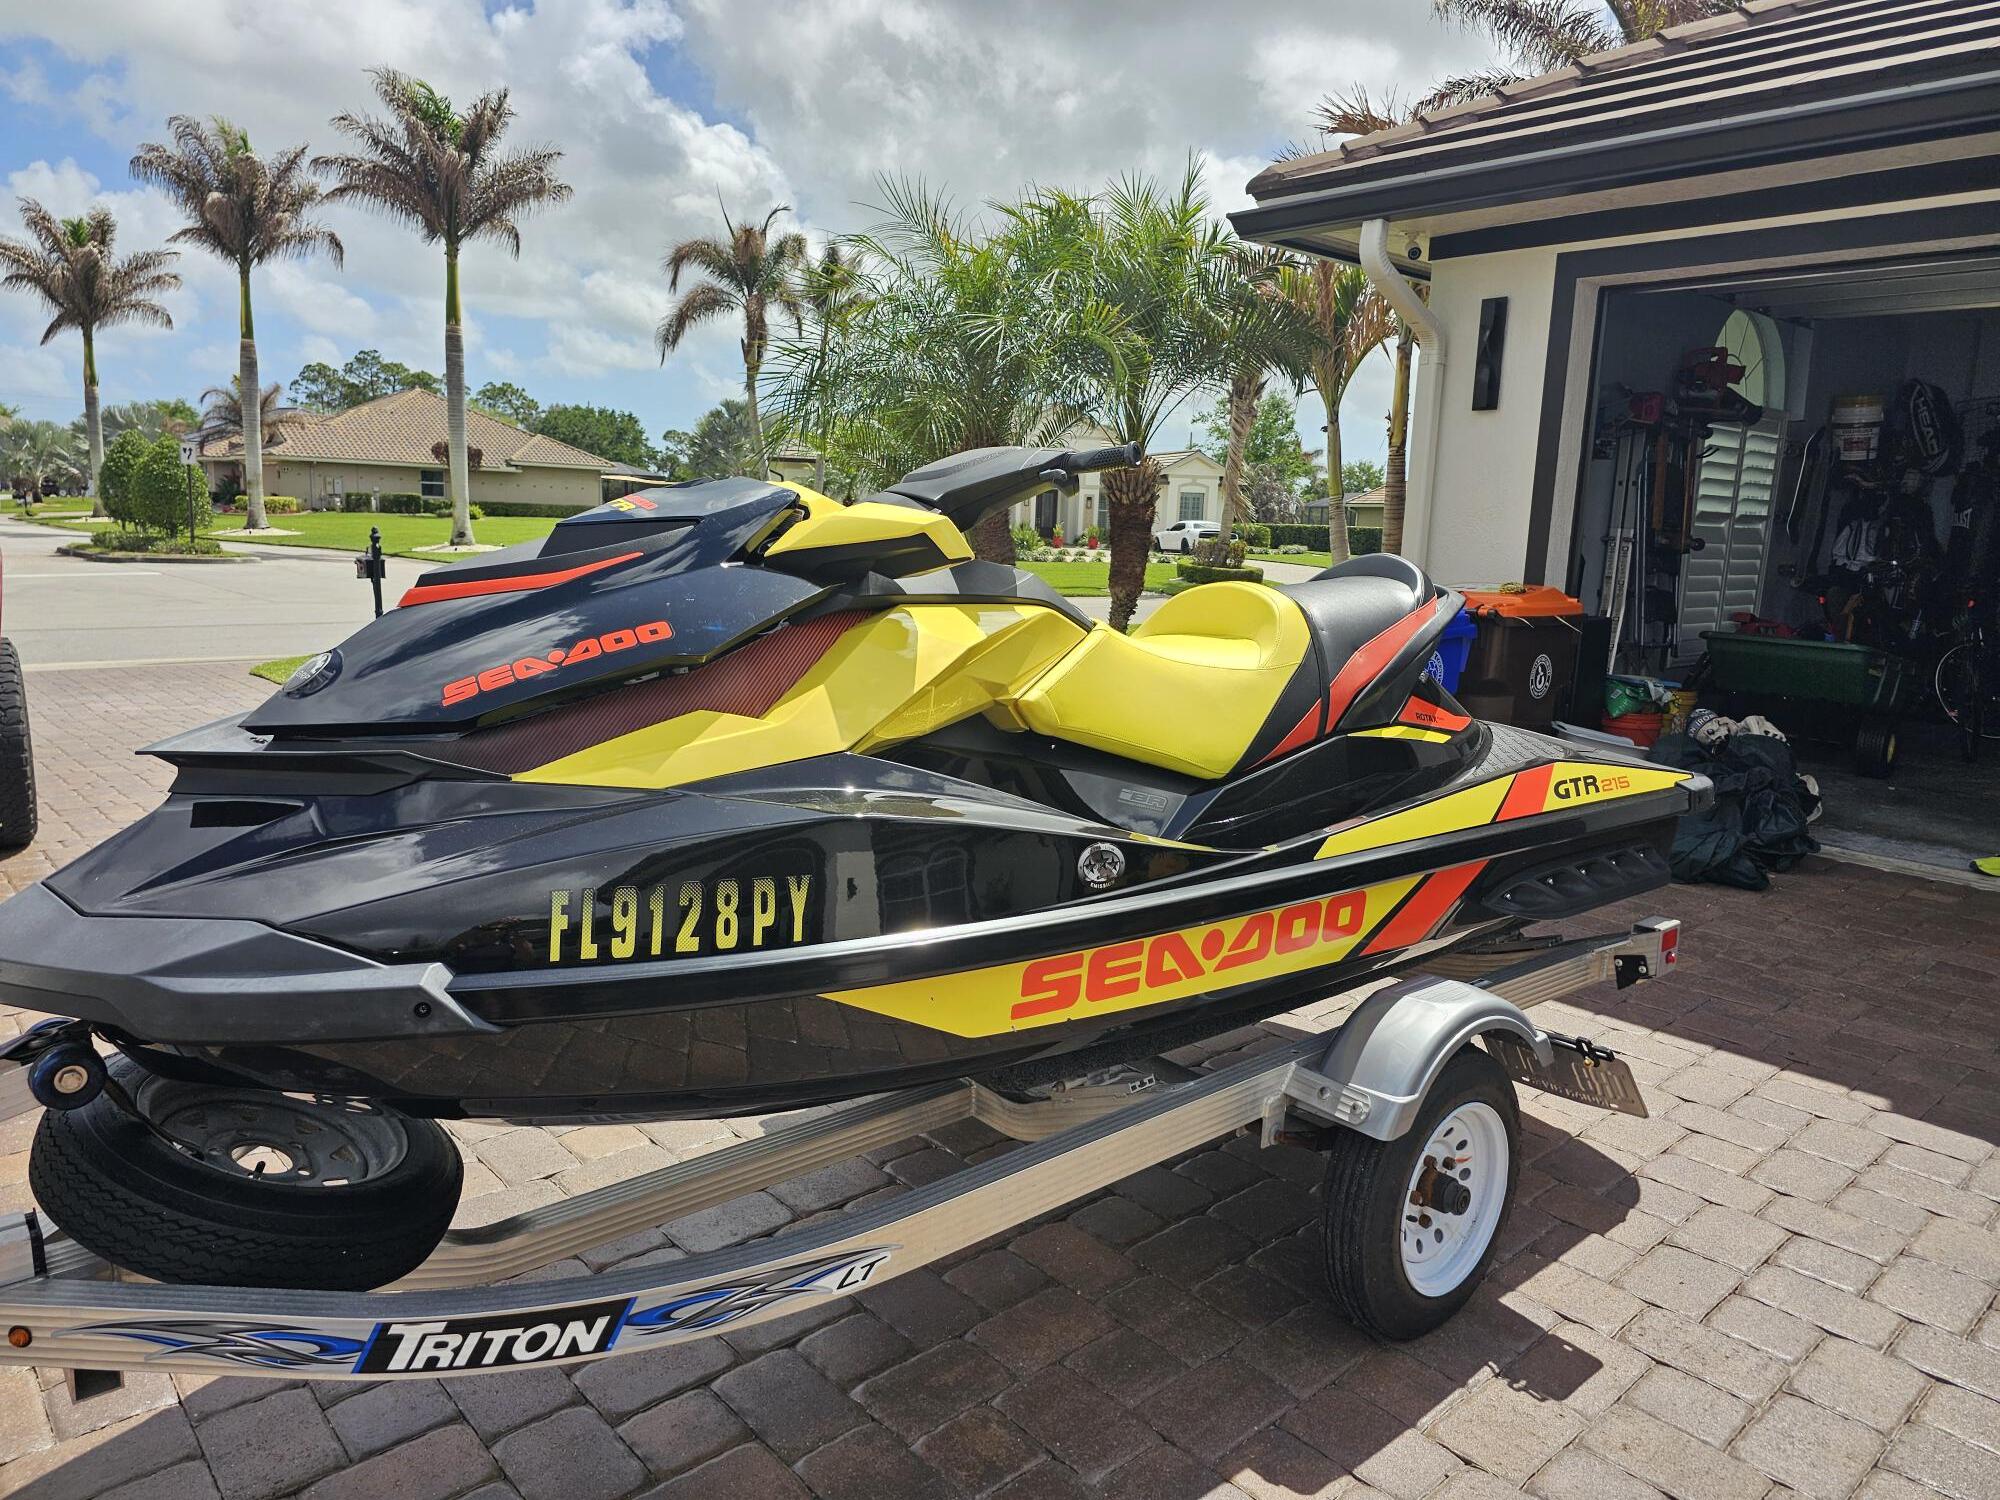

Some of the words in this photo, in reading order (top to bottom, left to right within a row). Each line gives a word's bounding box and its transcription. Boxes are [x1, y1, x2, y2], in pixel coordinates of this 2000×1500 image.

[1915, 396, 1938, 456] HEAD
[1415, 712, 1438, 723] ROTAX
[1553, 774, 1600, 799] GTR
[1600, 776, 1630, 792] 215
[549, 874, 812, 962] FL9128PY
[836, 1256, 888, 1290] LT
[386, 1315, 610, 1371] TRITON
